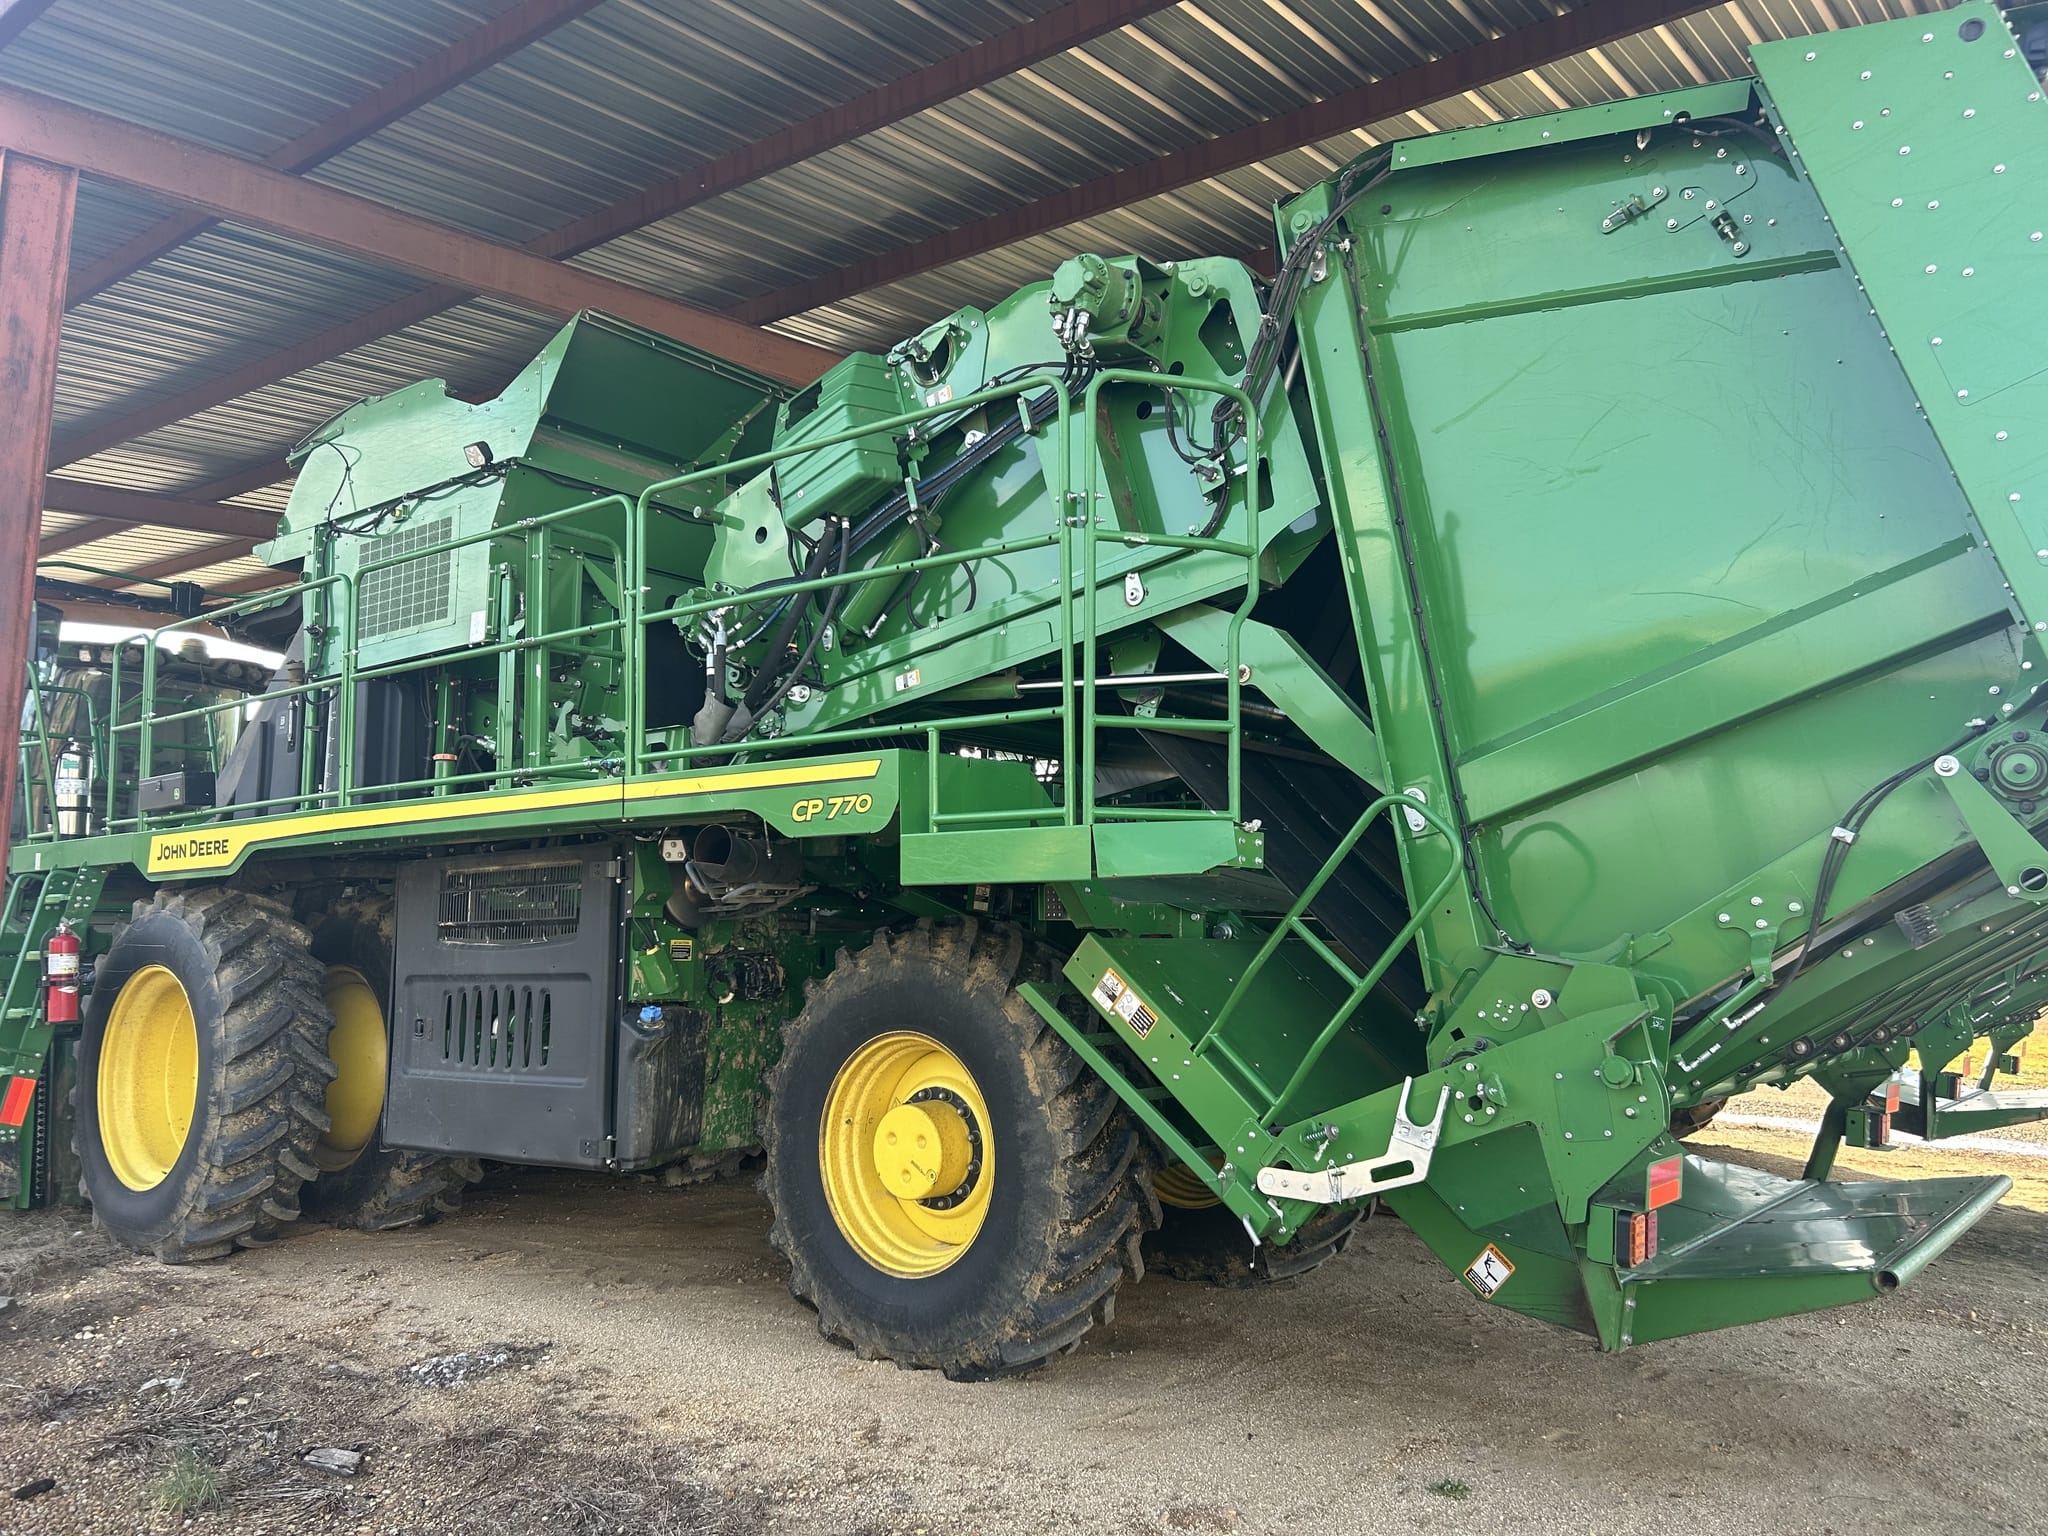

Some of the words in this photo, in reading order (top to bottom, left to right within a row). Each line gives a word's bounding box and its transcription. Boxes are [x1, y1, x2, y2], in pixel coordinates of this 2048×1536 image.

[792, 798, 824, 823] CP
[826, 793, 873, 820] 770
[157, 843, 187, 861] JOHN
[189, 839, 229, 857] DEERE
